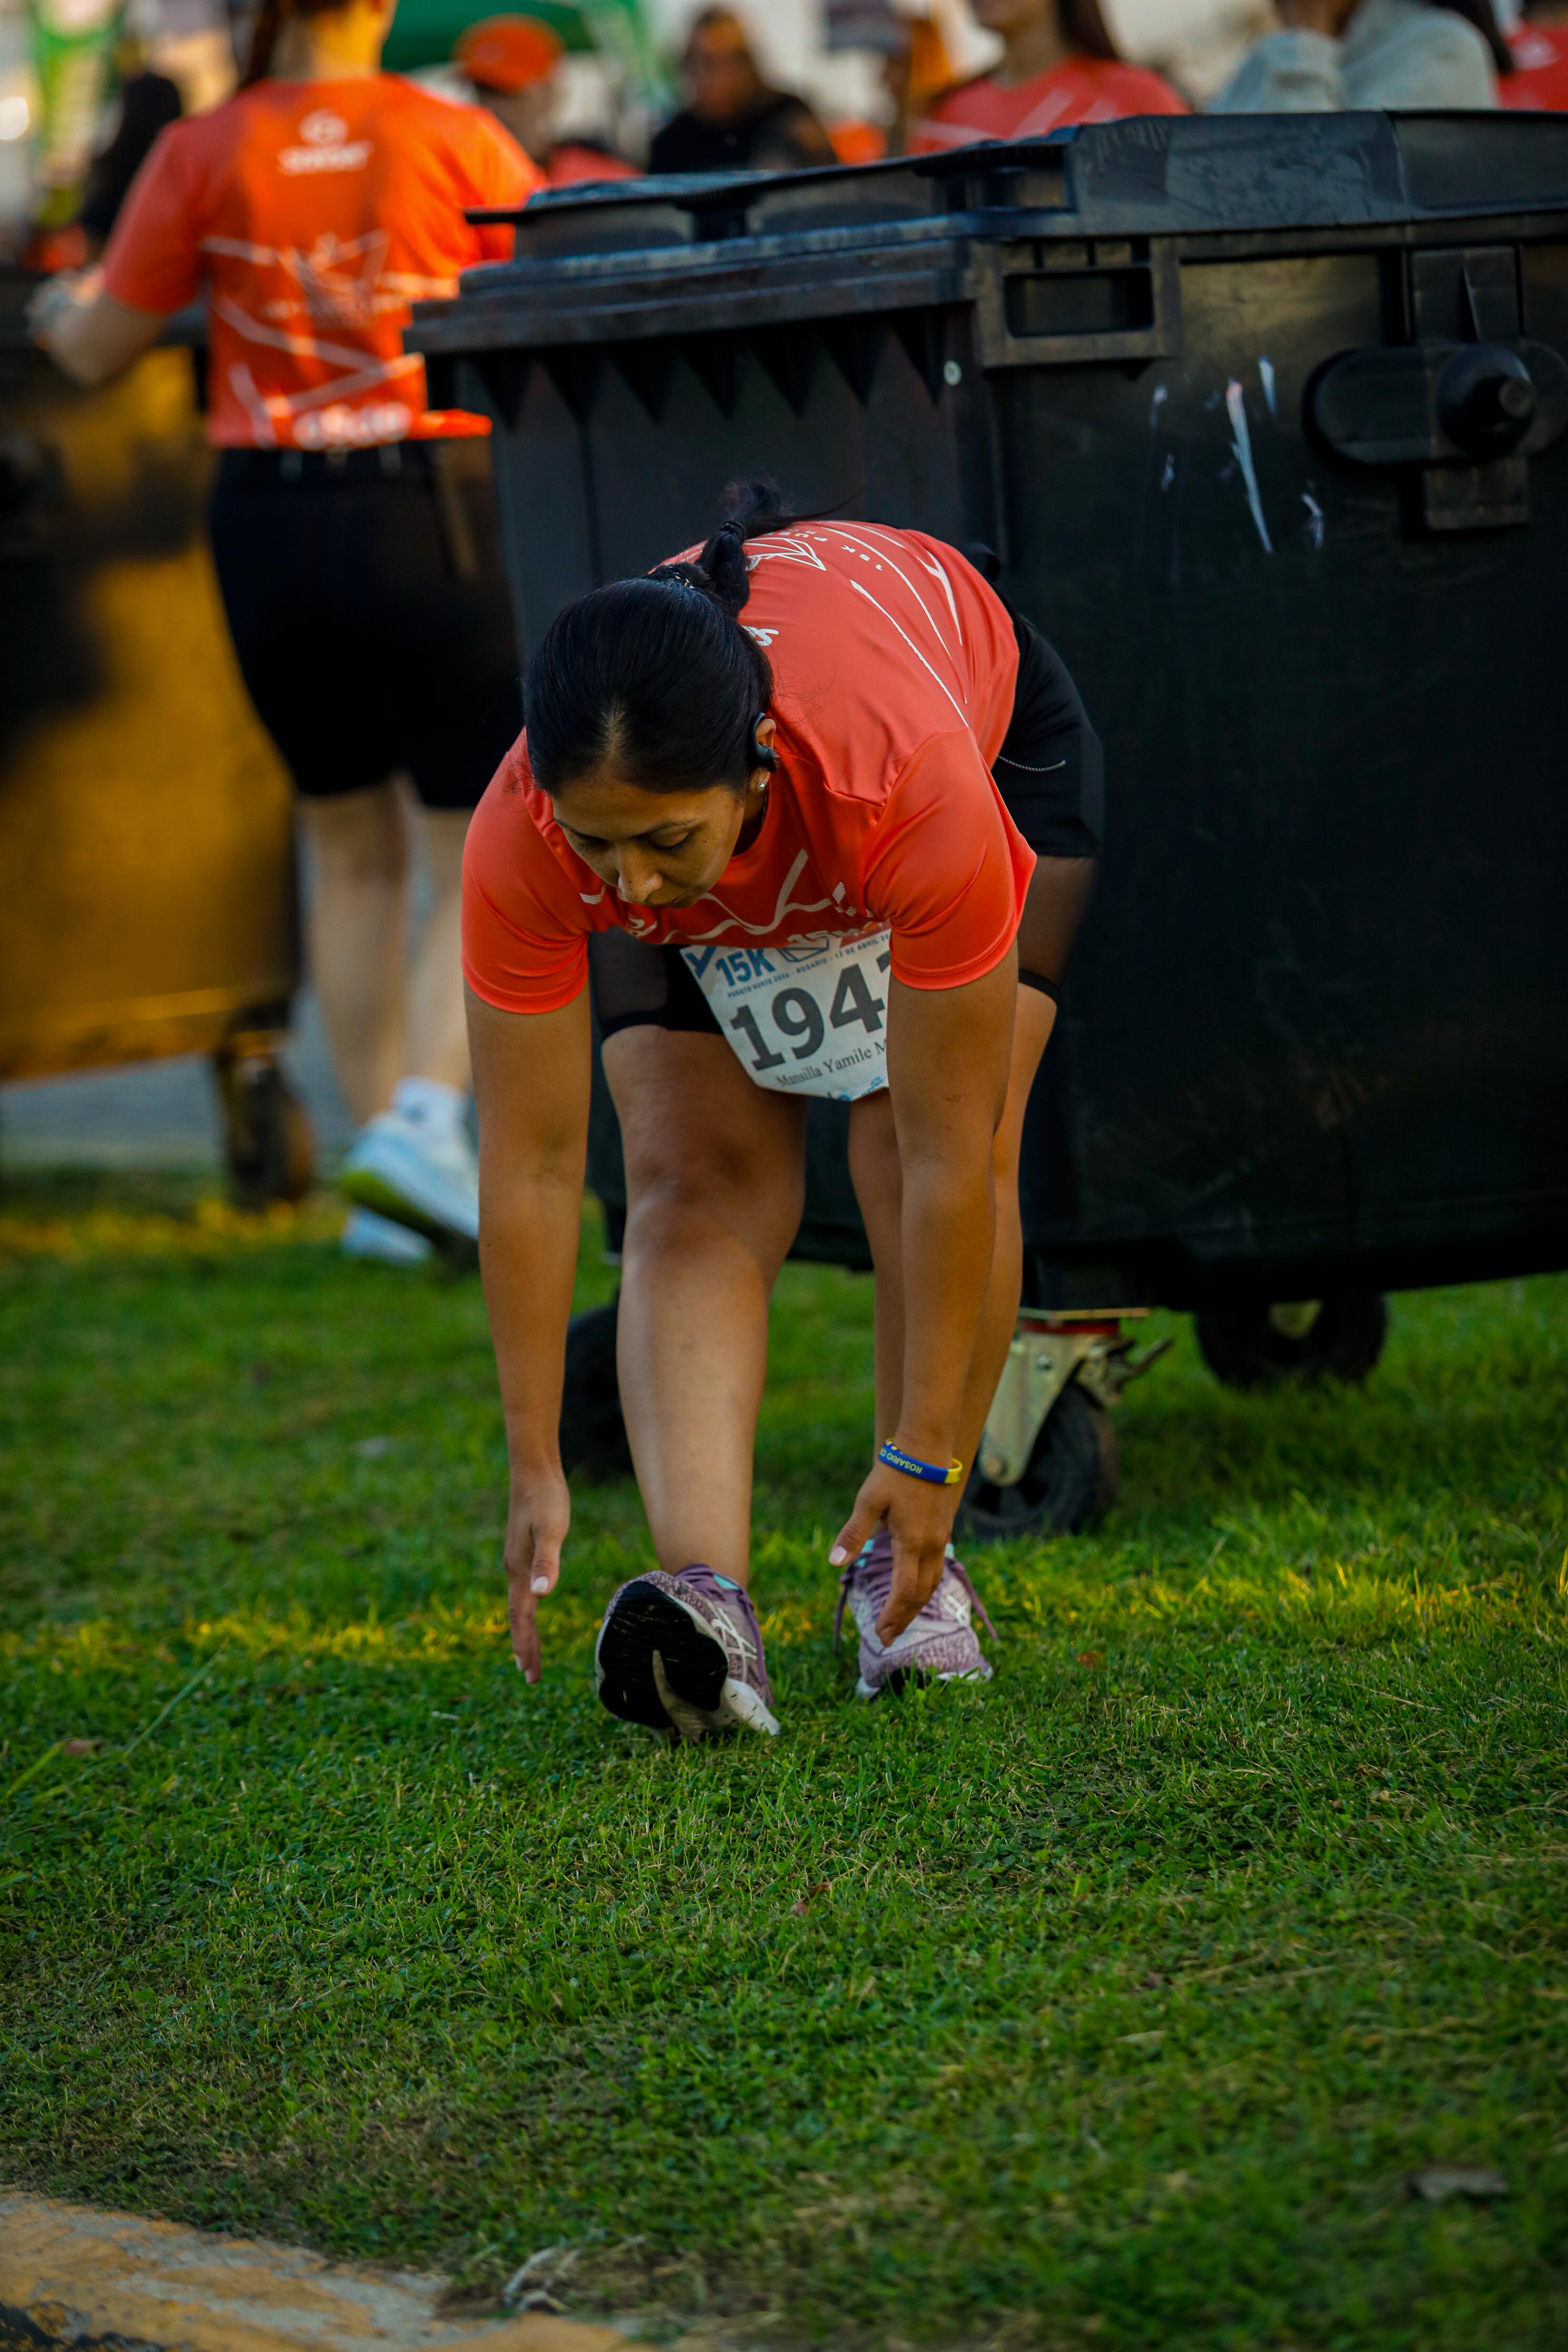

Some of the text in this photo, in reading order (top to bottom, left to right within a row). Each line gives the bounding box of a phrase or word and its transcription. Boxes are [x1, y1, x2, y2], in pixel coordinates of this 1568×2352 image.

[716, 948, 776, 987] 15K
[796, 957, 827, 974] ROSARIO
[845, 946, 856, 955] DE
[857, 938, 879, 950] ABRIL
[729, 949, 891, 1071] 194
[822, 1047, 873, 1073] Yamile
[886, 1453, 923, 1474] ROSARIO
